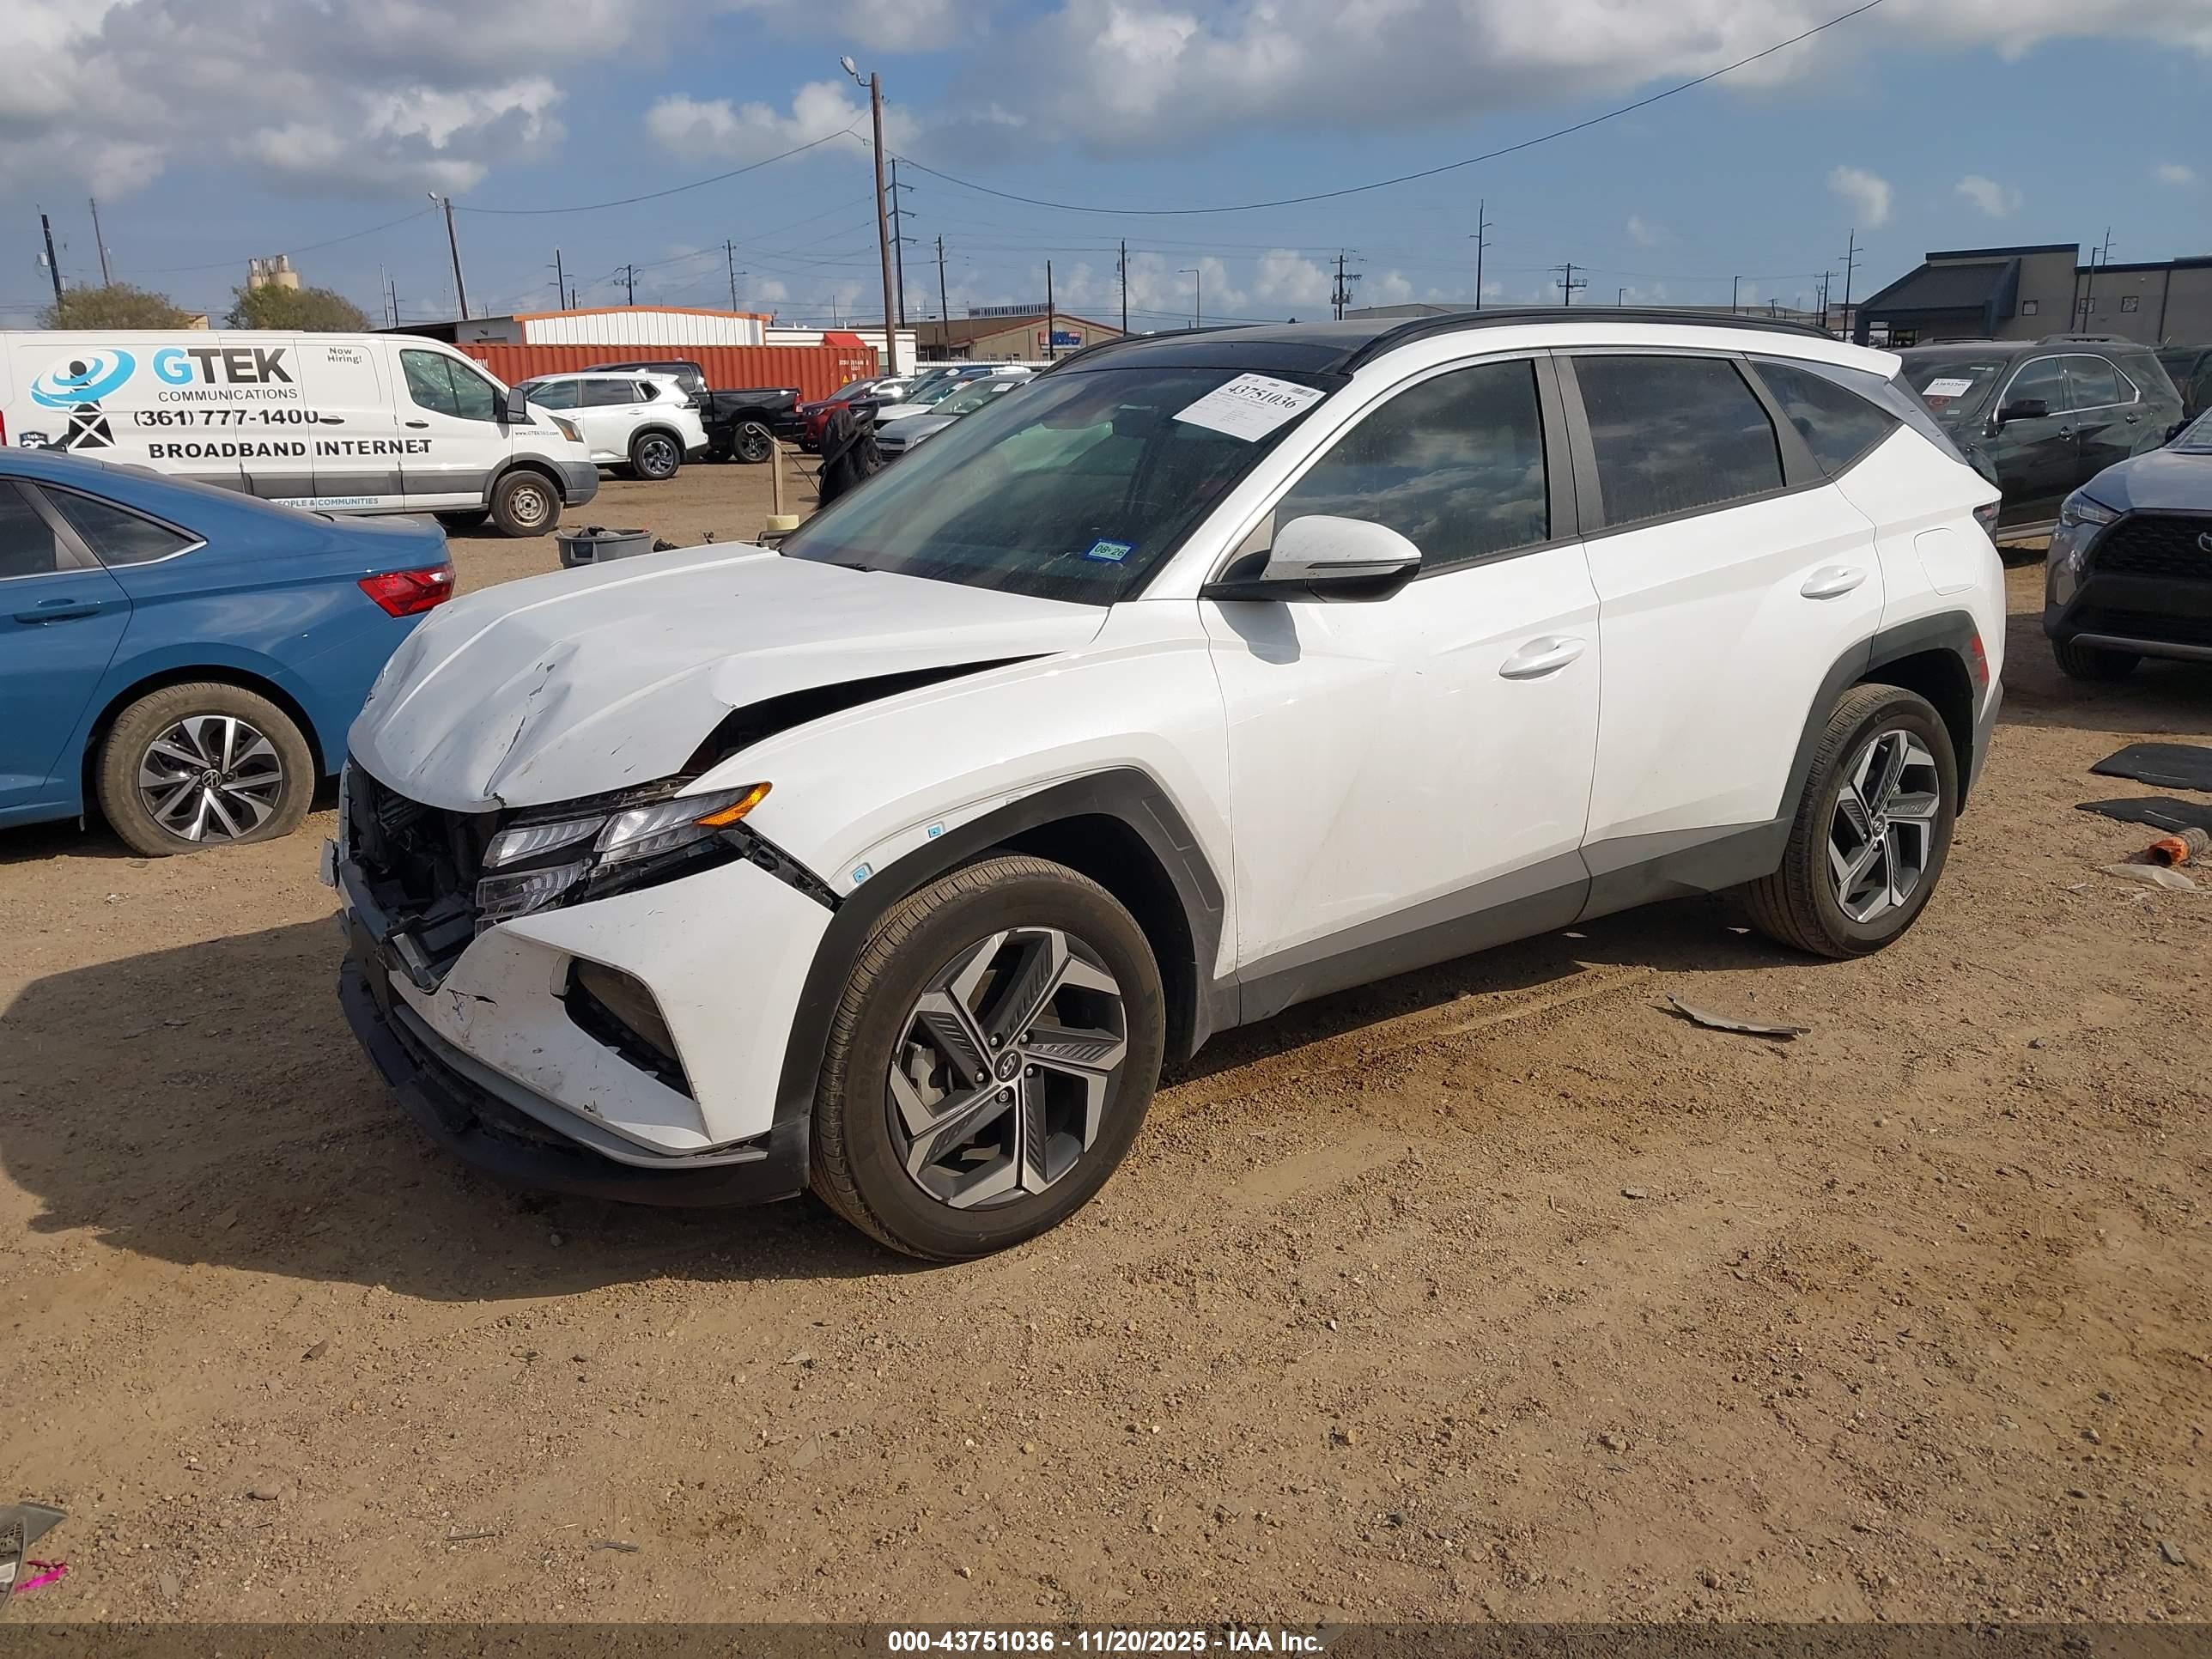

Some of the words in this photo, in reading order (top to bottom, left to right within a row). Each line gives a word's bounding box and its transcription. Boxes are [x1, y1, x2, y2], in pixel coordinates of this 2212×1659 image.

[153, 348, 294, 385] GTEK
[327, 354, 362, 365] Hiring!
[158, 388, 298, 402] COMMUNICATIONS
[1227, 384, 1304, 410] 43751036
[134, 410, 194, 427] (361)
[198, 409, 319, 426] 777-1400
[148, 441, 307, 459] BROADBAND
[316, 439, 433, 456] INTERNET
[318, 498, 380, 507] COMMUNITIES
